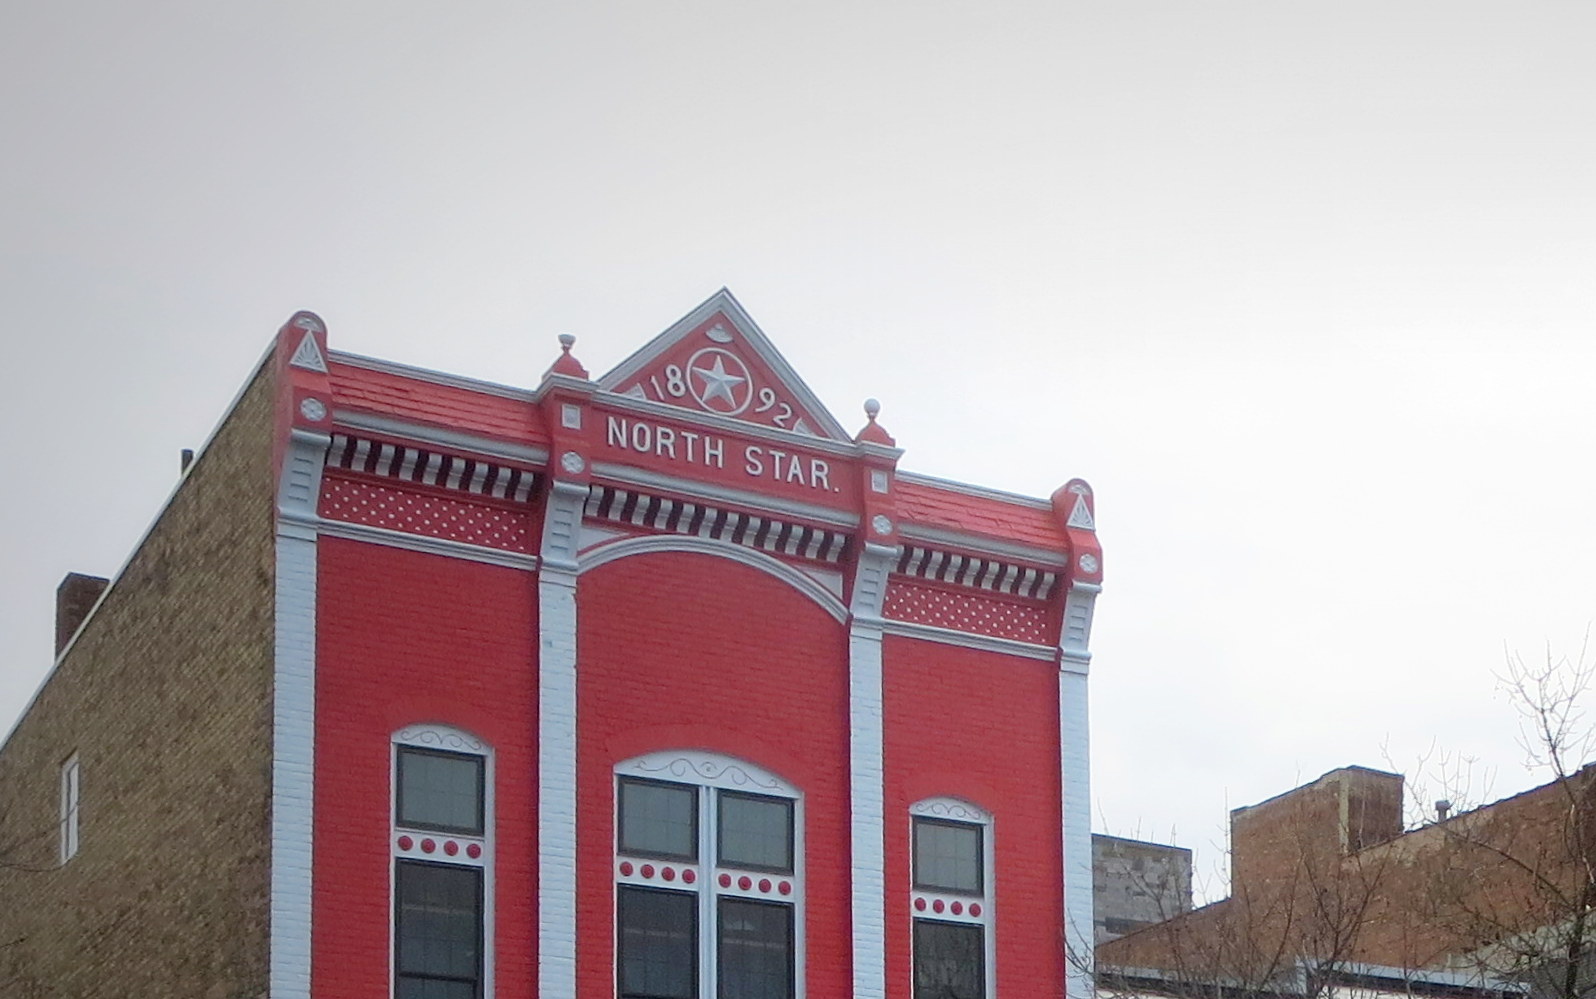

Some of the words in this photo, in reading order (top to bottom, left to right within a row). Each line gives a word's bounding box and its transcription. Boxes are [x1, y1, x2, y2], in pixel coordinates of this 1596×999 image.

[650, 363, 687, 400] 18
[755, 387, 792, 428] 92
[606, 415, 724, 468] NORTH
